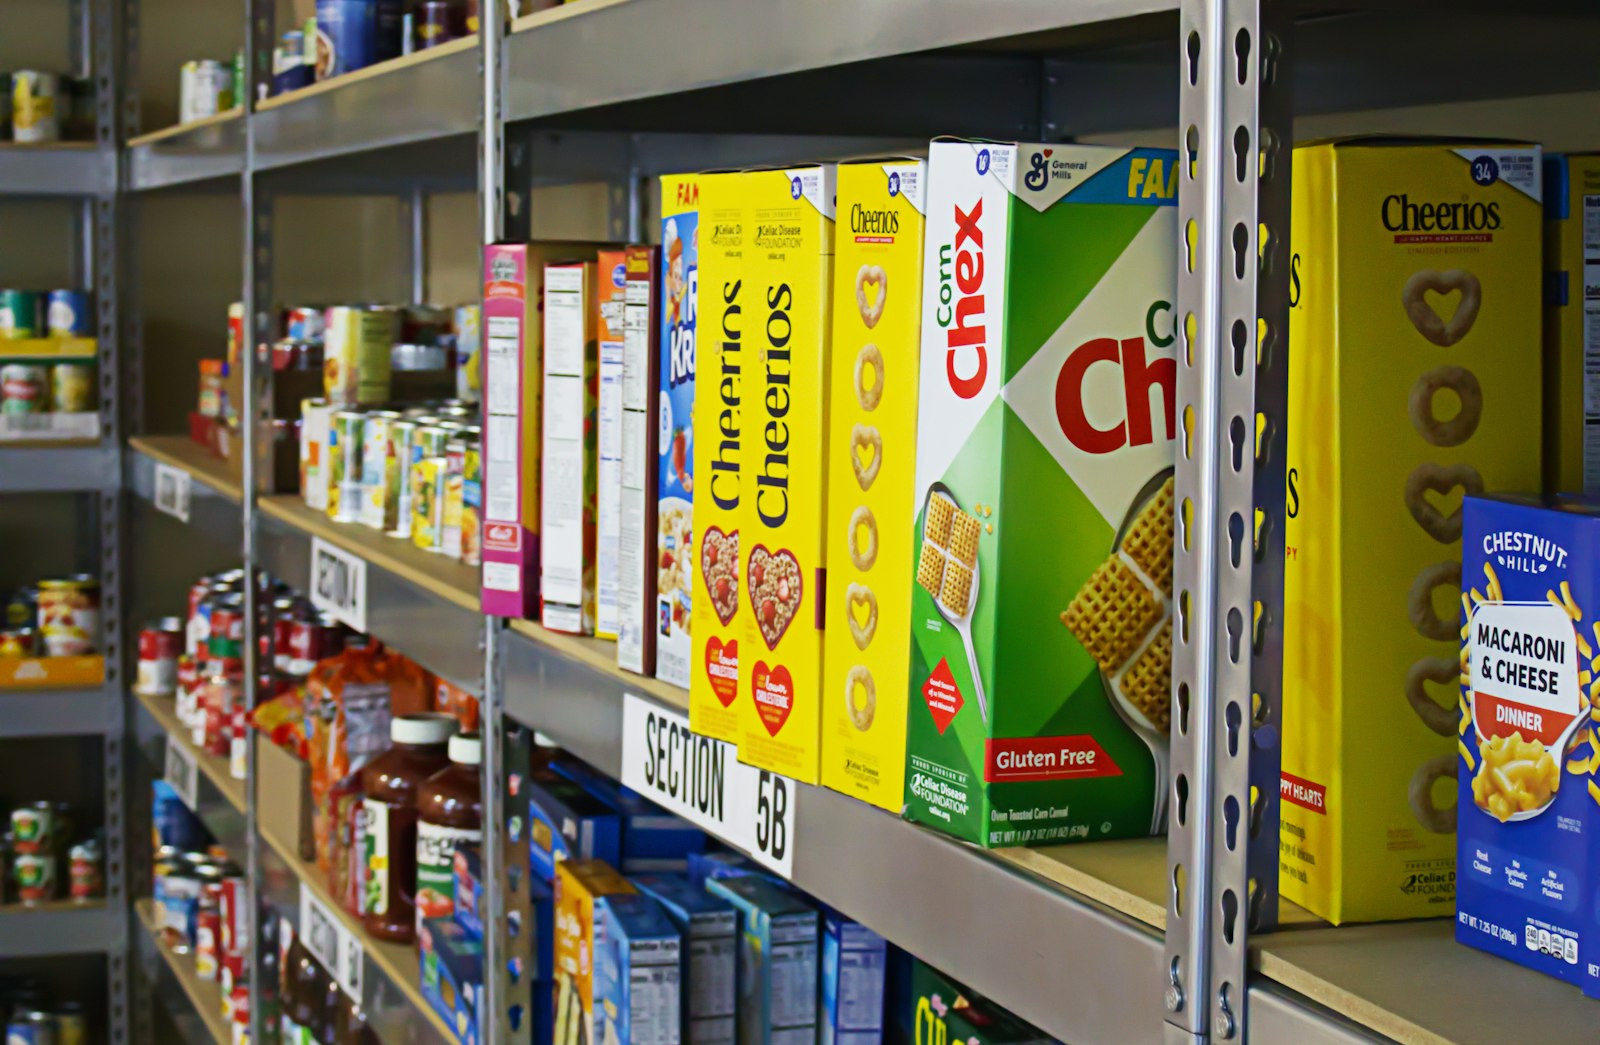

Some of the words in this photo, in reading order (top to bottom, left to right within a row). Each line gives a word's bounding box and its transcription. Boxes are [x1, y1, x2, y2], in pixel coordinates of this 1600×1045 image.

[1051, 170, 1072, 180] Mills
[1052, 160, 1088, 171] General
[850, 202, 899, 234] Cheerios
[1381, 193, 1502, 232] Cheerios
[762, 225, 777, 236] Celiac
[778, 224, 801, 236] Disease
[936, 243, 952, 328] Corn
[946, 195, 989, 400] Chex
[1146, 300, 1178, 348] C
[756, 283, 793, 529] Cheerios
[1482, 531, 1568, 568] CHESTNUT
[1506, 555, 1538, 574] HILL
[1477, 622, 1565, 664] MACARONI
[1481, 655, 1492, 681] &
[1496, 659, 1559, 695] CHEESE
[1496, 704, 1543, 733] DINNER
[996, 750, 1057, 770] Gluten
[1060, 748, 1096, 767] Free
[645, 711, 725, 823] SECTION
[756, 770, 788, 862] 5B
[920, 774, 940, 793] Celiac
[940, 782, 967, 803] Disease
[1293, 782, 1323, 808] HEARTS
[991, 809, 1008, 822] Oven
[1008, 808, 1034, 820] Toasted
[989, 831, 1003, 844] NET
[1472, 859, 1492, 875] Cheese
[1512, 859, 1521, 869] No
[1417, 873, 1447, 884] Celiac
[1508, 877, 1524, 889] Colors
[1541, 877, 1564, 891] Artificial
[1548, 869, 1557, 880] No
[1417, 883, 1456, 895] FOUND
[1542, 887, 1563, 901] Flavors
[1459, 910, 1469, 925] NET
[1468, 914, 1479, 929] WT.
[1478, 918, 1490, 934] 7.25
[1490, 923, 1499, 938] OZ
[1526, 927, 1537, 939] 240
[1587, 962, 1600, 978] NET
